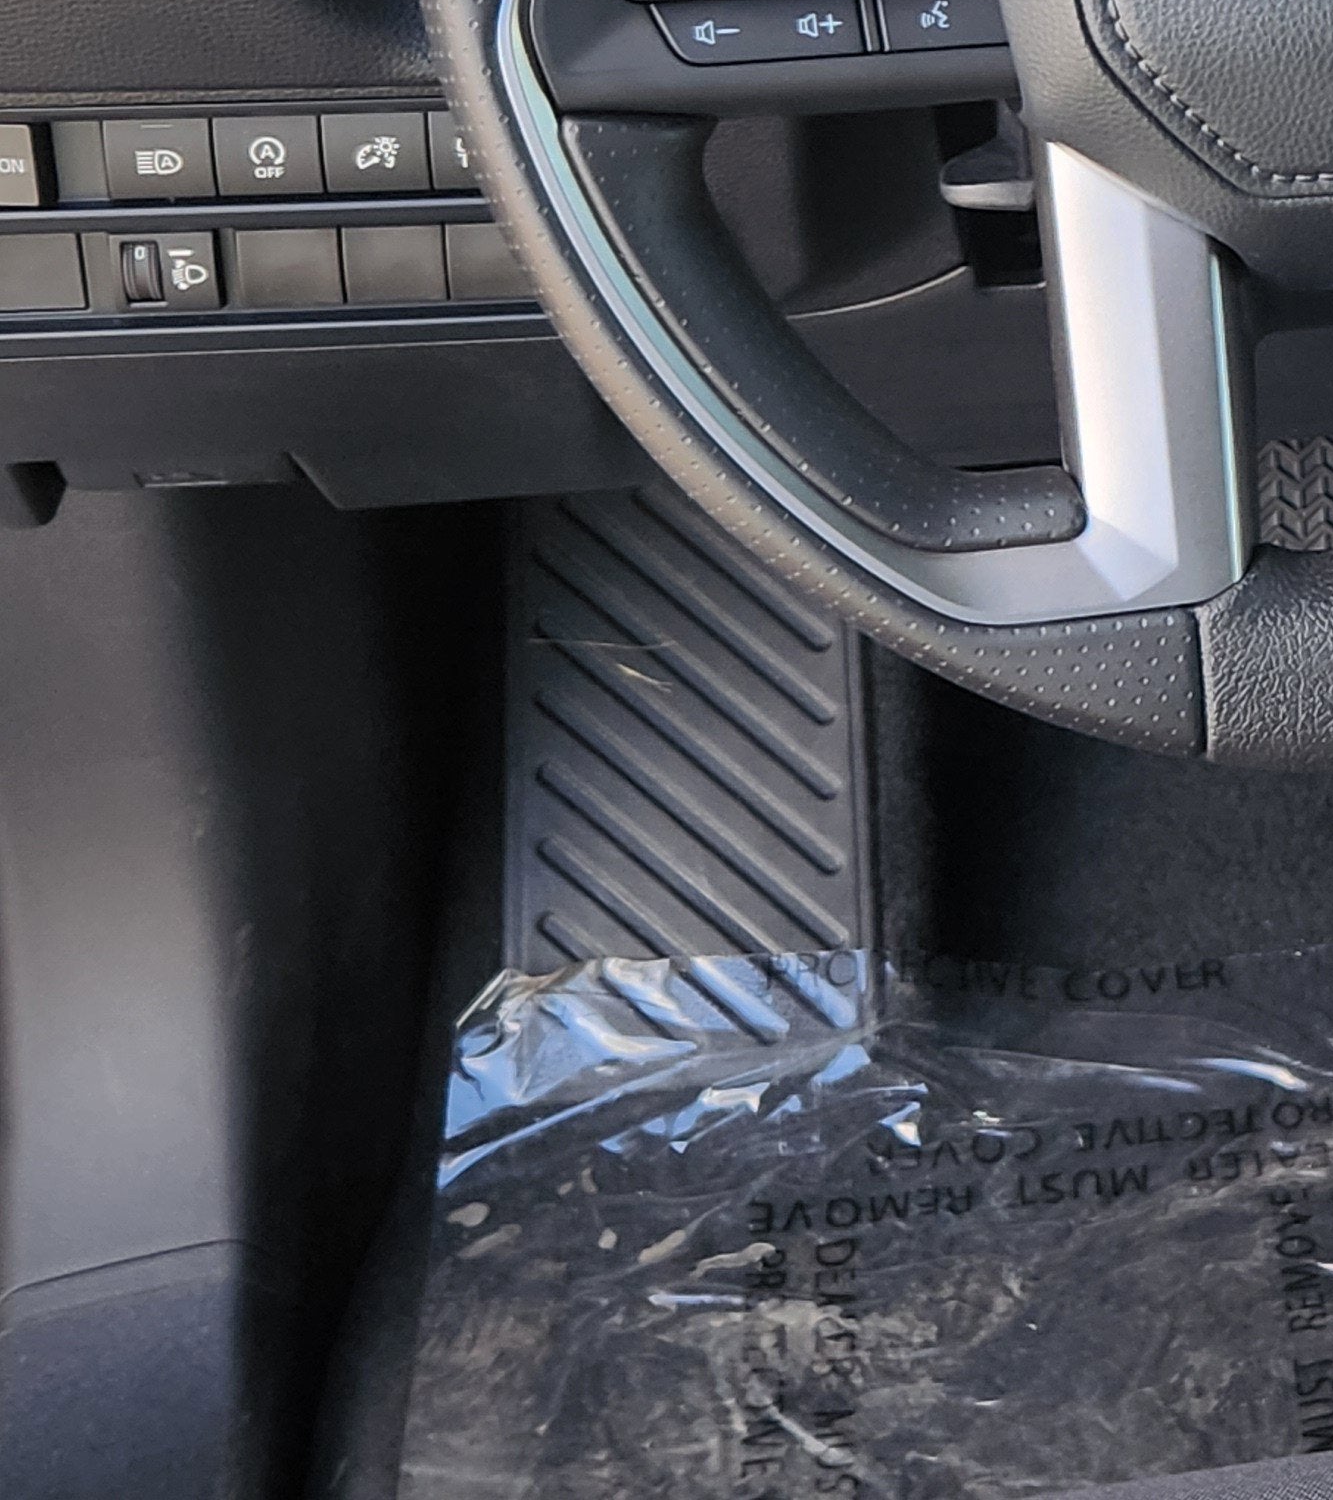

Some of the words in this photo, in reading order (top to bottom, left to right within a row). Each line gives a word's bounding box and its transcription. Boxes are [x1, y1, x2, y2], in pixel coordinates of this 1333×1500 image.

[254, 166, 285, 179] OFF
[134, 246, 146, 261] 0
[1018, 1164, 1149, 1203] MUST
[750, 1184, 976, 1234] REMOVE
